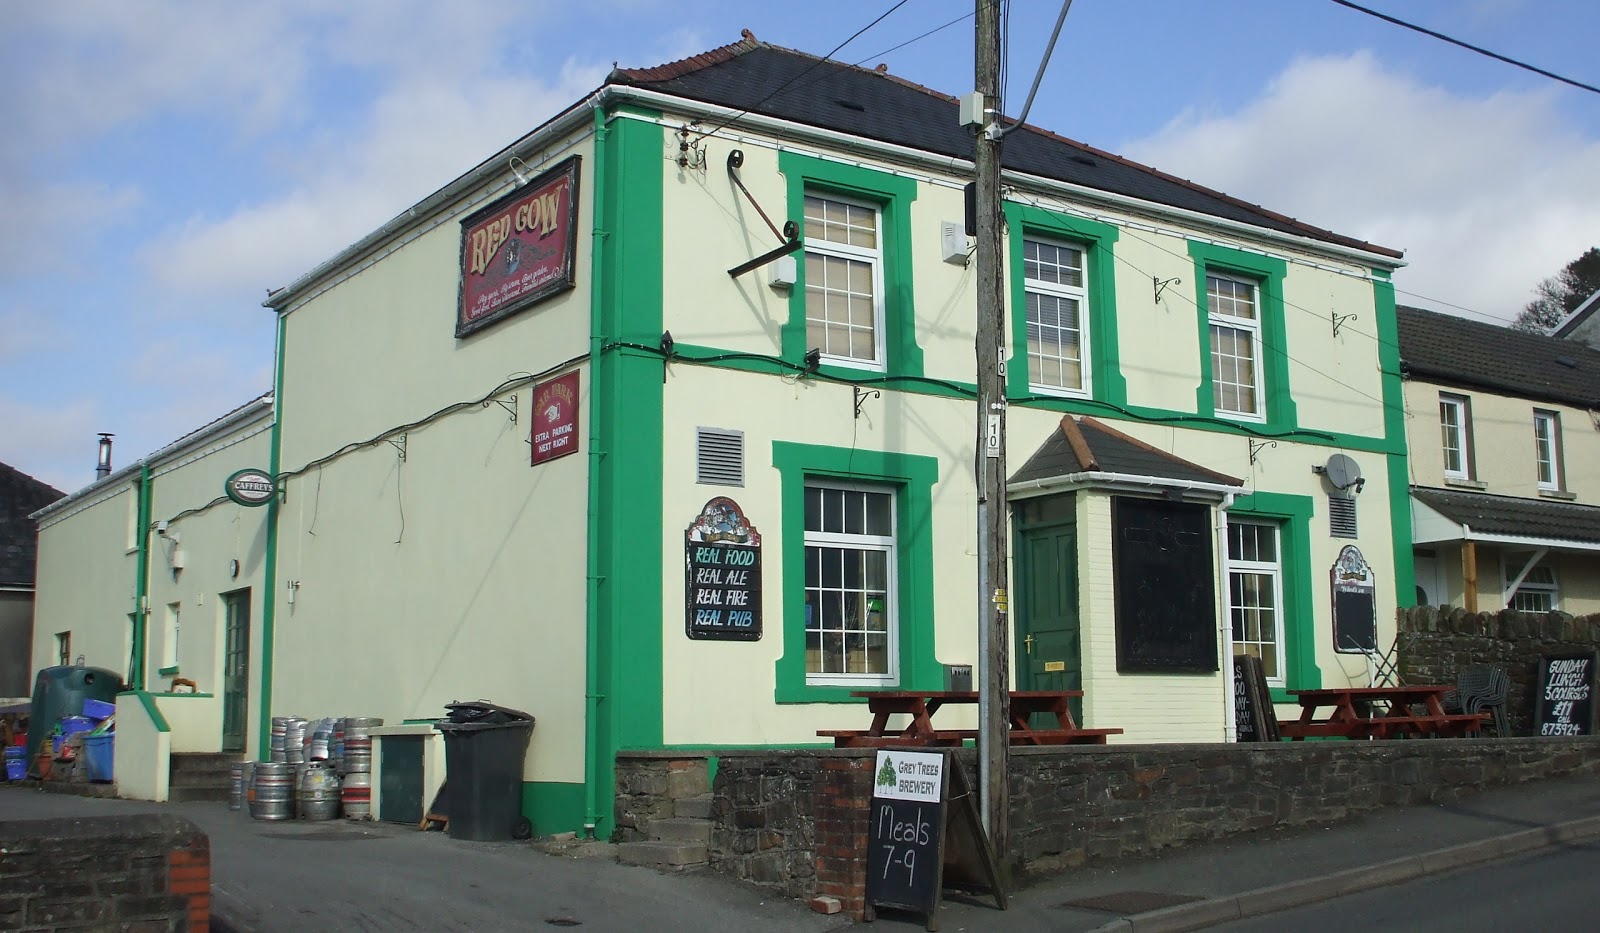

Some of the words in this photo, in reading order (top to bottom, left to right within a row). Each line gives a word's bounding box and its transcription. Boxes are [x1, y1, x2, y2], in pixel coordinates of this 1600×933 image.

[470, 214, 512, 276] RED
[515, 184, 564, 237] COW
[535, 431, 550, 443] EXTRA
[552, 423, 573, 438] PARKING
[538, 441, 552, 453] NEXT
[552, 436, 569, 449] RIGHT
[695, 546, 722, 565] REAL
[724, 549, 755, 566] FOOD
[696, 567, 723, 585] REAL
[725, 569, 749, 586] ALE
[696, 588, 723, 606] REAL
[725, 590, 749, 606] FIRE
[695, 609, 723, 627] REAL
[727, 611, 753, 627] PUB
[1549, 659, 1588, 674] SUNDAY
[1549, 673, 1584, 687] LUNCH
[1552, 701, 1573, 716] £11
[1557, 716, 1571, 724] CALL
[1541, 723, 1580, 736] 873924
[898, 760, 916, 775] GREY
[917, 761, 939, 776] TREES
[898, 779, 936, 795] BREWERY
[877, 804, 931, 846] Meals
[883, 844, 916, 888] 7-9
